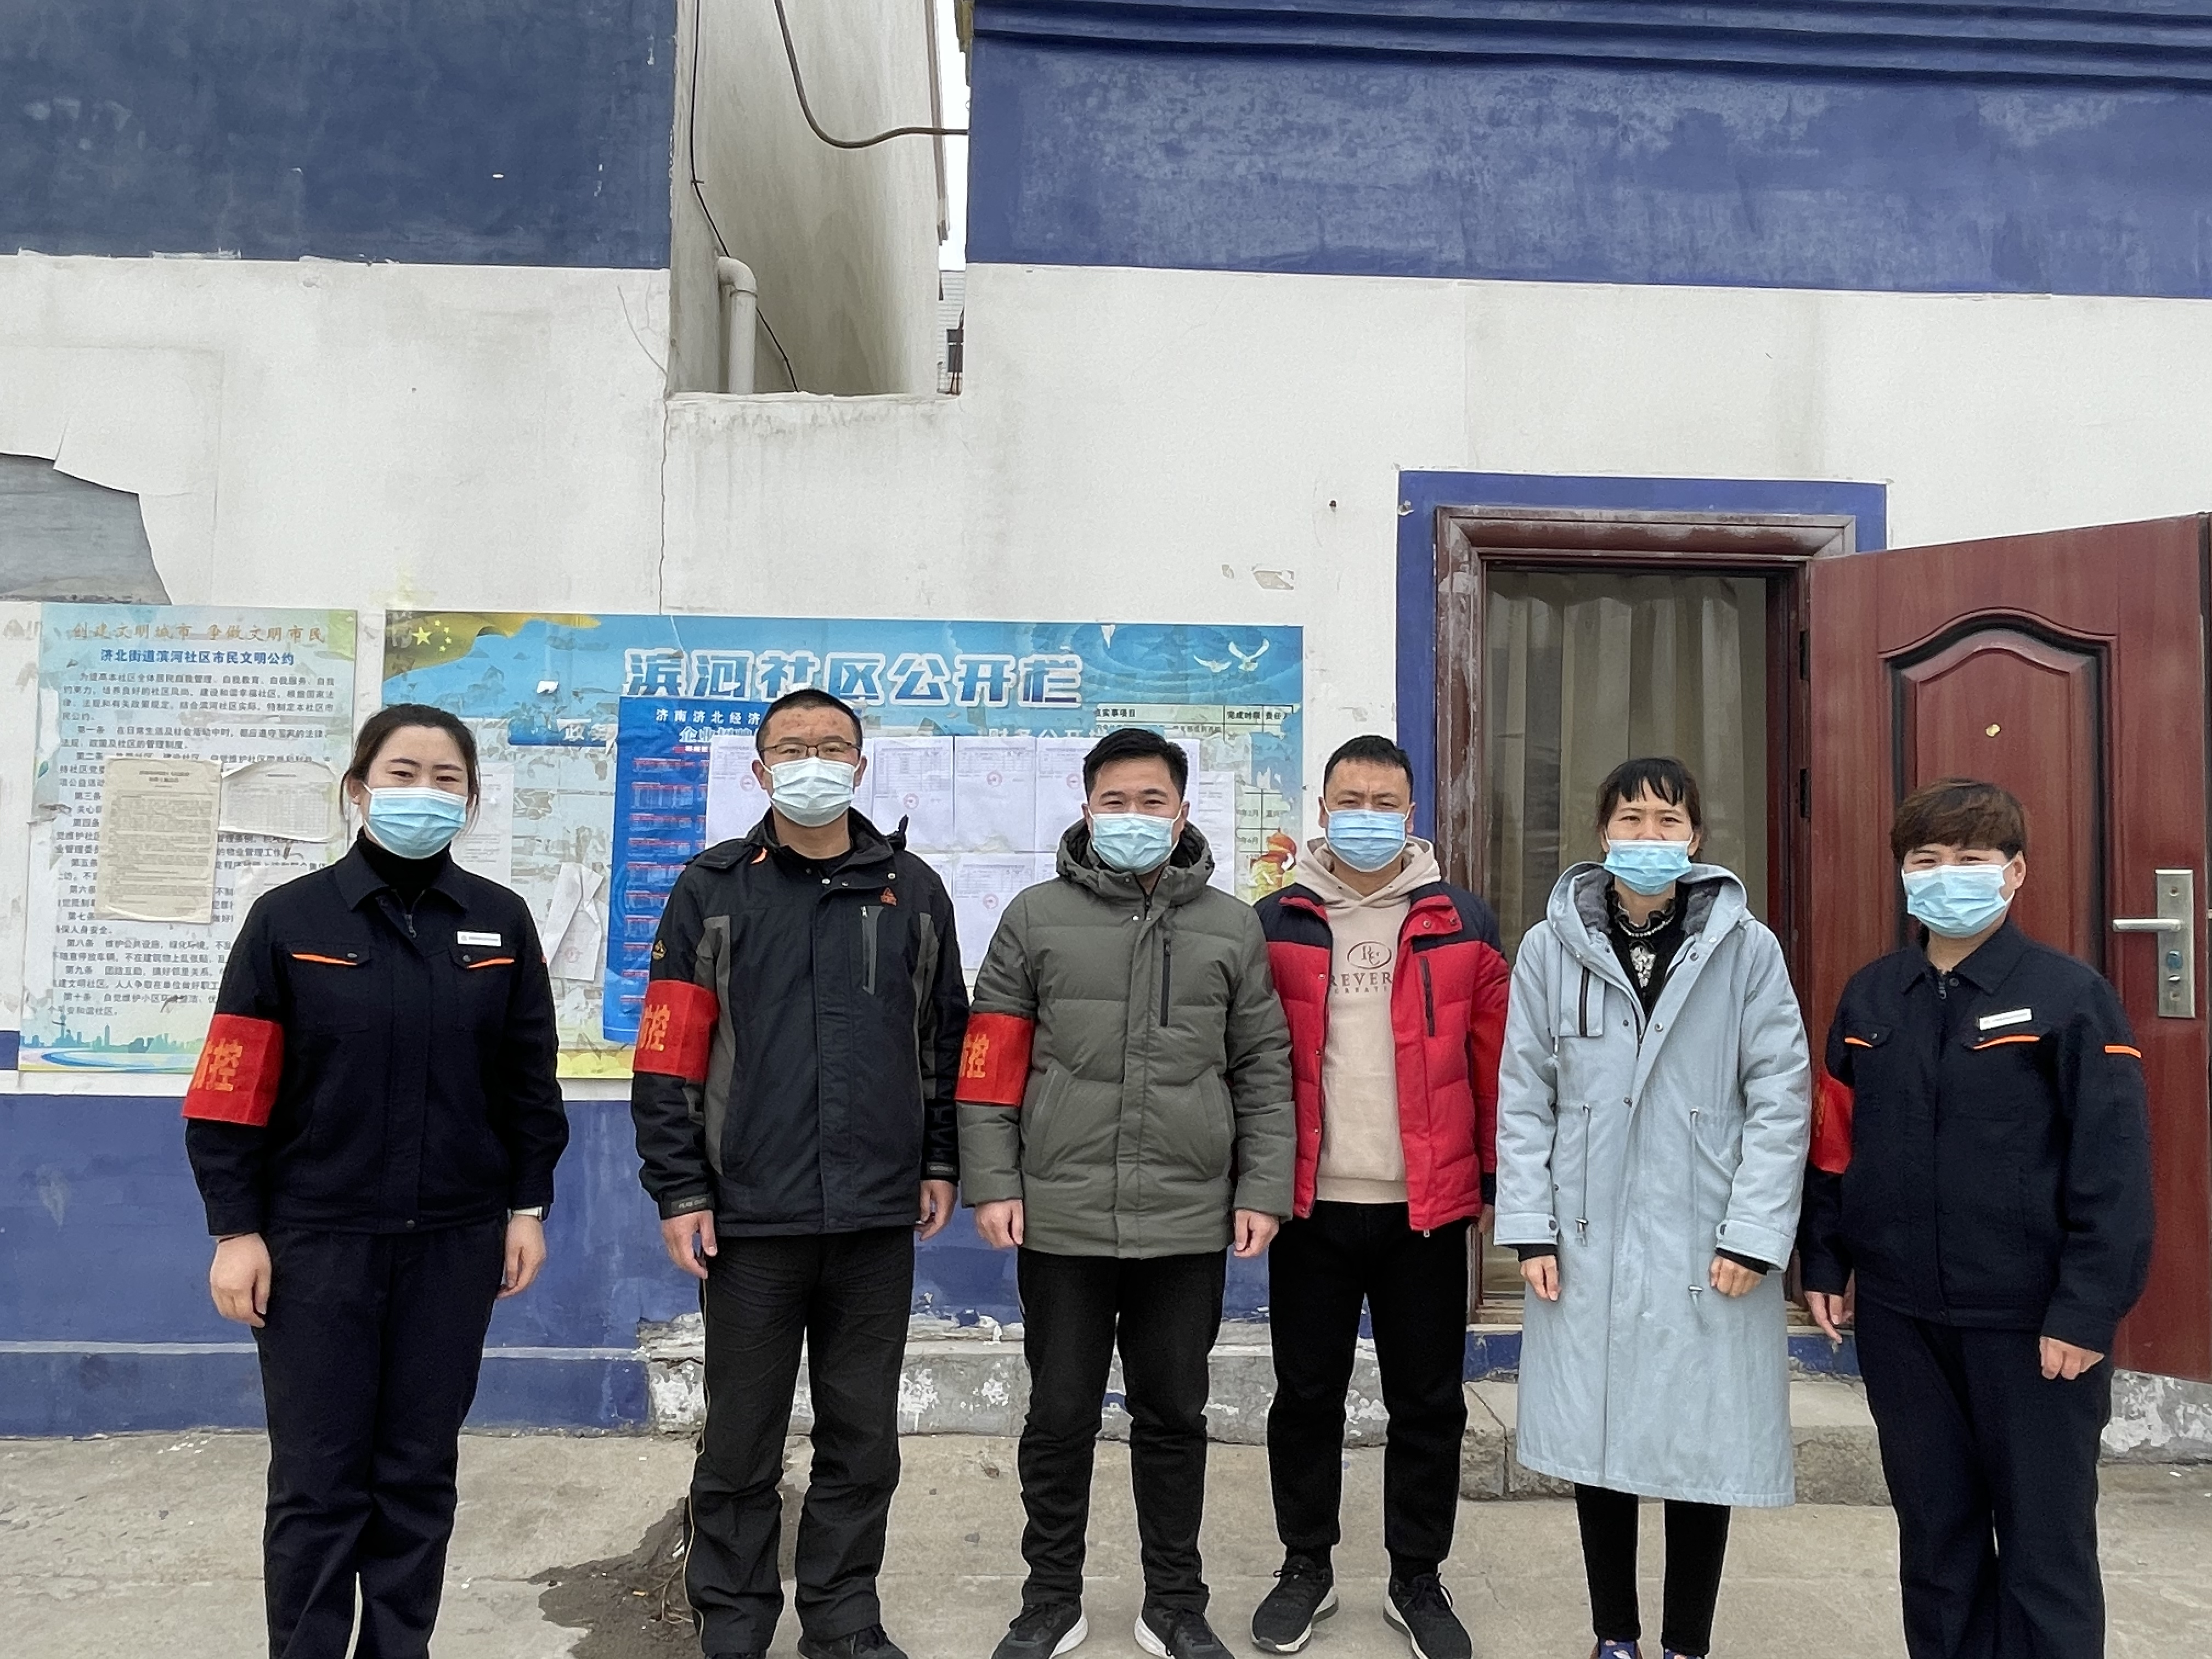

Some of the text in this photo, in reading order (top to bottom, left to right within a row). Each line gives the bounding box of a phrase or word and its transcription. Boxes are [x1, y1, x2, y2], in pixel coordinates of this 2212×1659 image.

[72, 623, 326, 644] 创建文明城市 争做文明市民
[101, 648, 295, 665] 济北街道滨河社区市民文明公约
[656, 709, 760, 725] 济南济北经济
